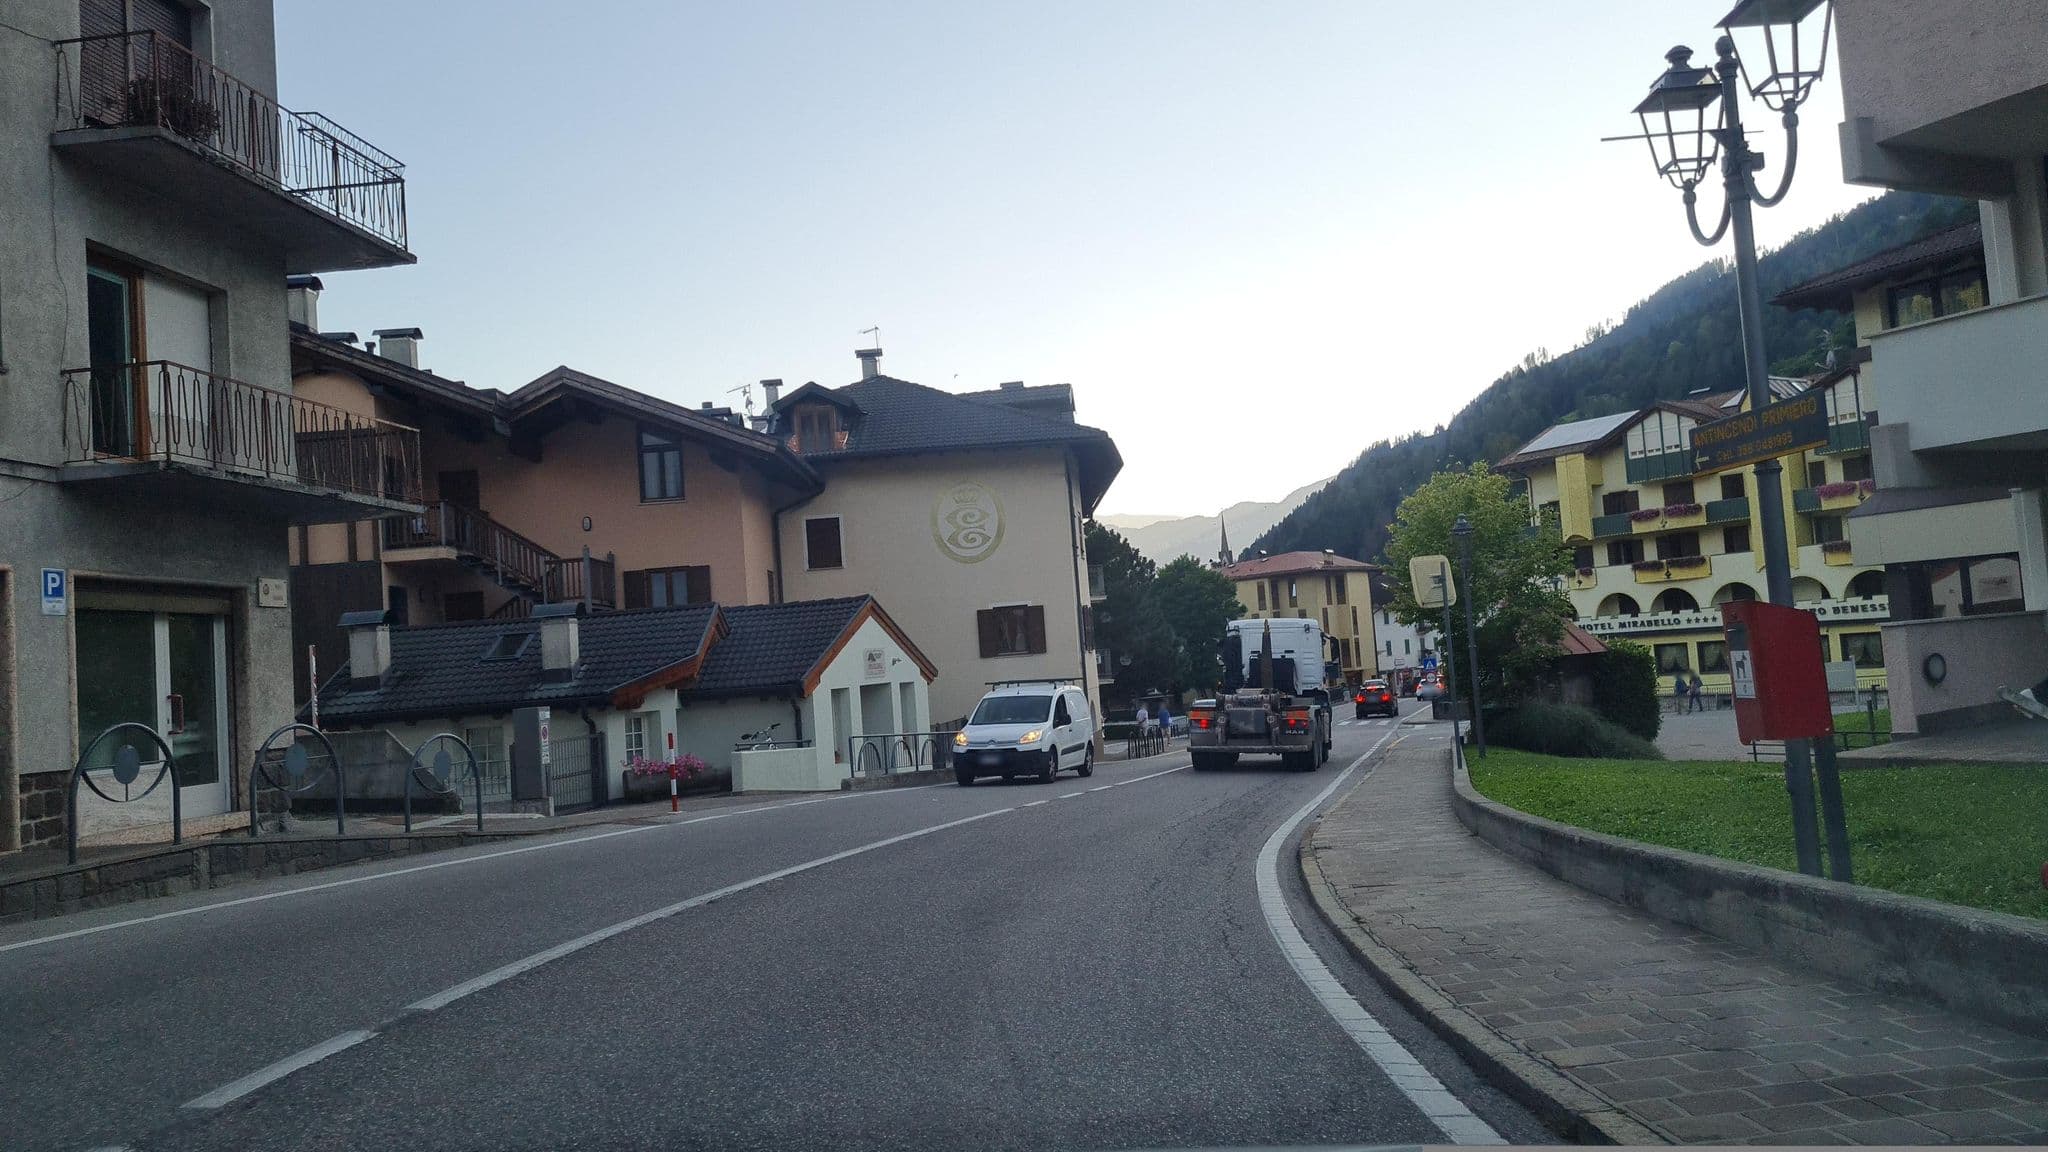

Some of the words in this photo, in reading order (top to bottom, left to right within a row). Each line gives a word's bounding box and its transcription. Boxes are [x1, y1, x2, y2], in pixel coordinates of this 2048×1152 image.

[1695, 416, 1757, 447] ANTINCENDI
[47, 572, 61, 595] P
[1832, 603, 1889, 616] BENESS
[1579, 622, 1614, 632] HOTEL
[1618, 617, 1682, 629] MIRABELLO
